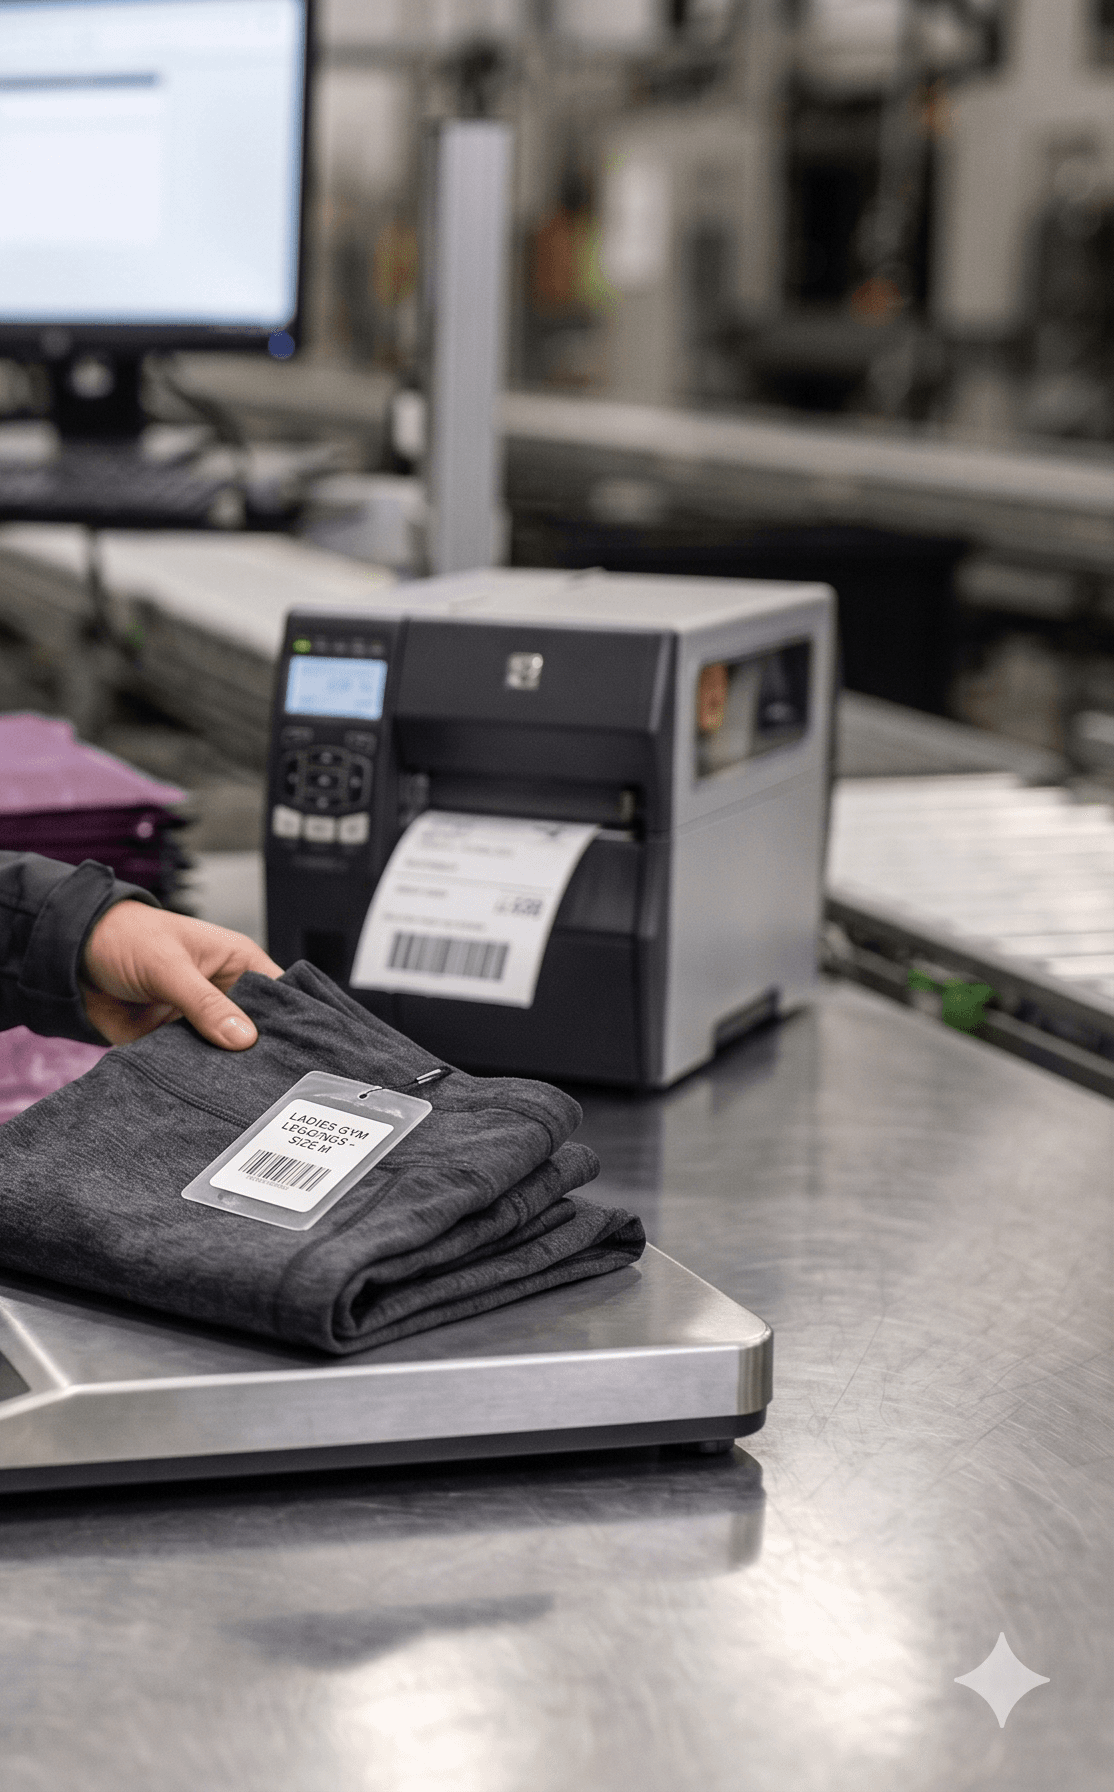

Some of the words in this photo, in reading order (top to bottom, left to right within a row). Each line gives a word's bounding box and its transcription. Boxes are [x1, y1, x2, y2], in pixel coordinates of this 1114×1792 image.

[289, 1112, 338, 1132] LADIES
[338, 1126, 370, 1141] GYM
[288, 1136, 319, 1150] SIZE
